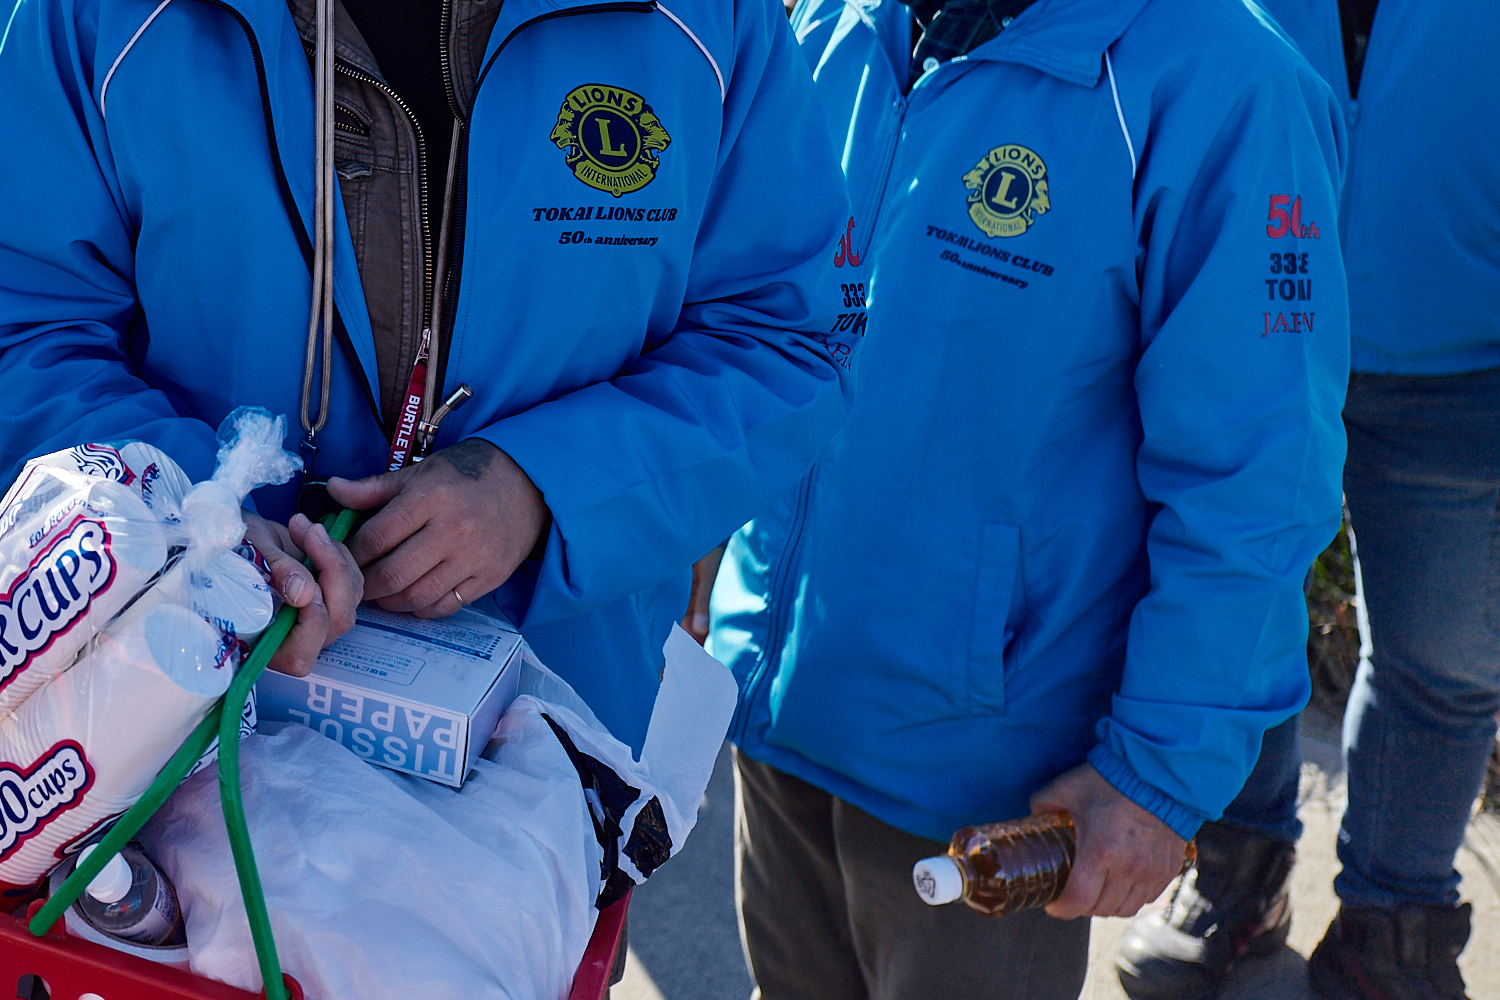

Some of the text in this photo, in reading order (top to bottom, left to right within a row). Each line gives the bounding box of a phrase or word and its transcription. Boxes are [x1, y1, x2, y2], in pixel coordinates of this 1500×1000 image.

[571, 88, 639, 112] LIONS
[594, 117, 628, 157] L
[580, 164, 649, 188] INTERNATIONAL
[994, 148, 1043, 176] LIONS
[991, 171, 1018, 210] L
[532, 206, 678, 222] TOKAI LIONS CLUB
[972, 206, 1023, 234] INTERNATIONAL
[558, 230, 659, 247] 50th anniversary
[926, 225, 1055, 277] TOKAI LIONS CLUB
[395, 394, 421, 449] BURTLE
[29, 524, 48, 548] For
[15, 529, 110, 642] CUPS
[306, 682, 459, 750] PAPER
